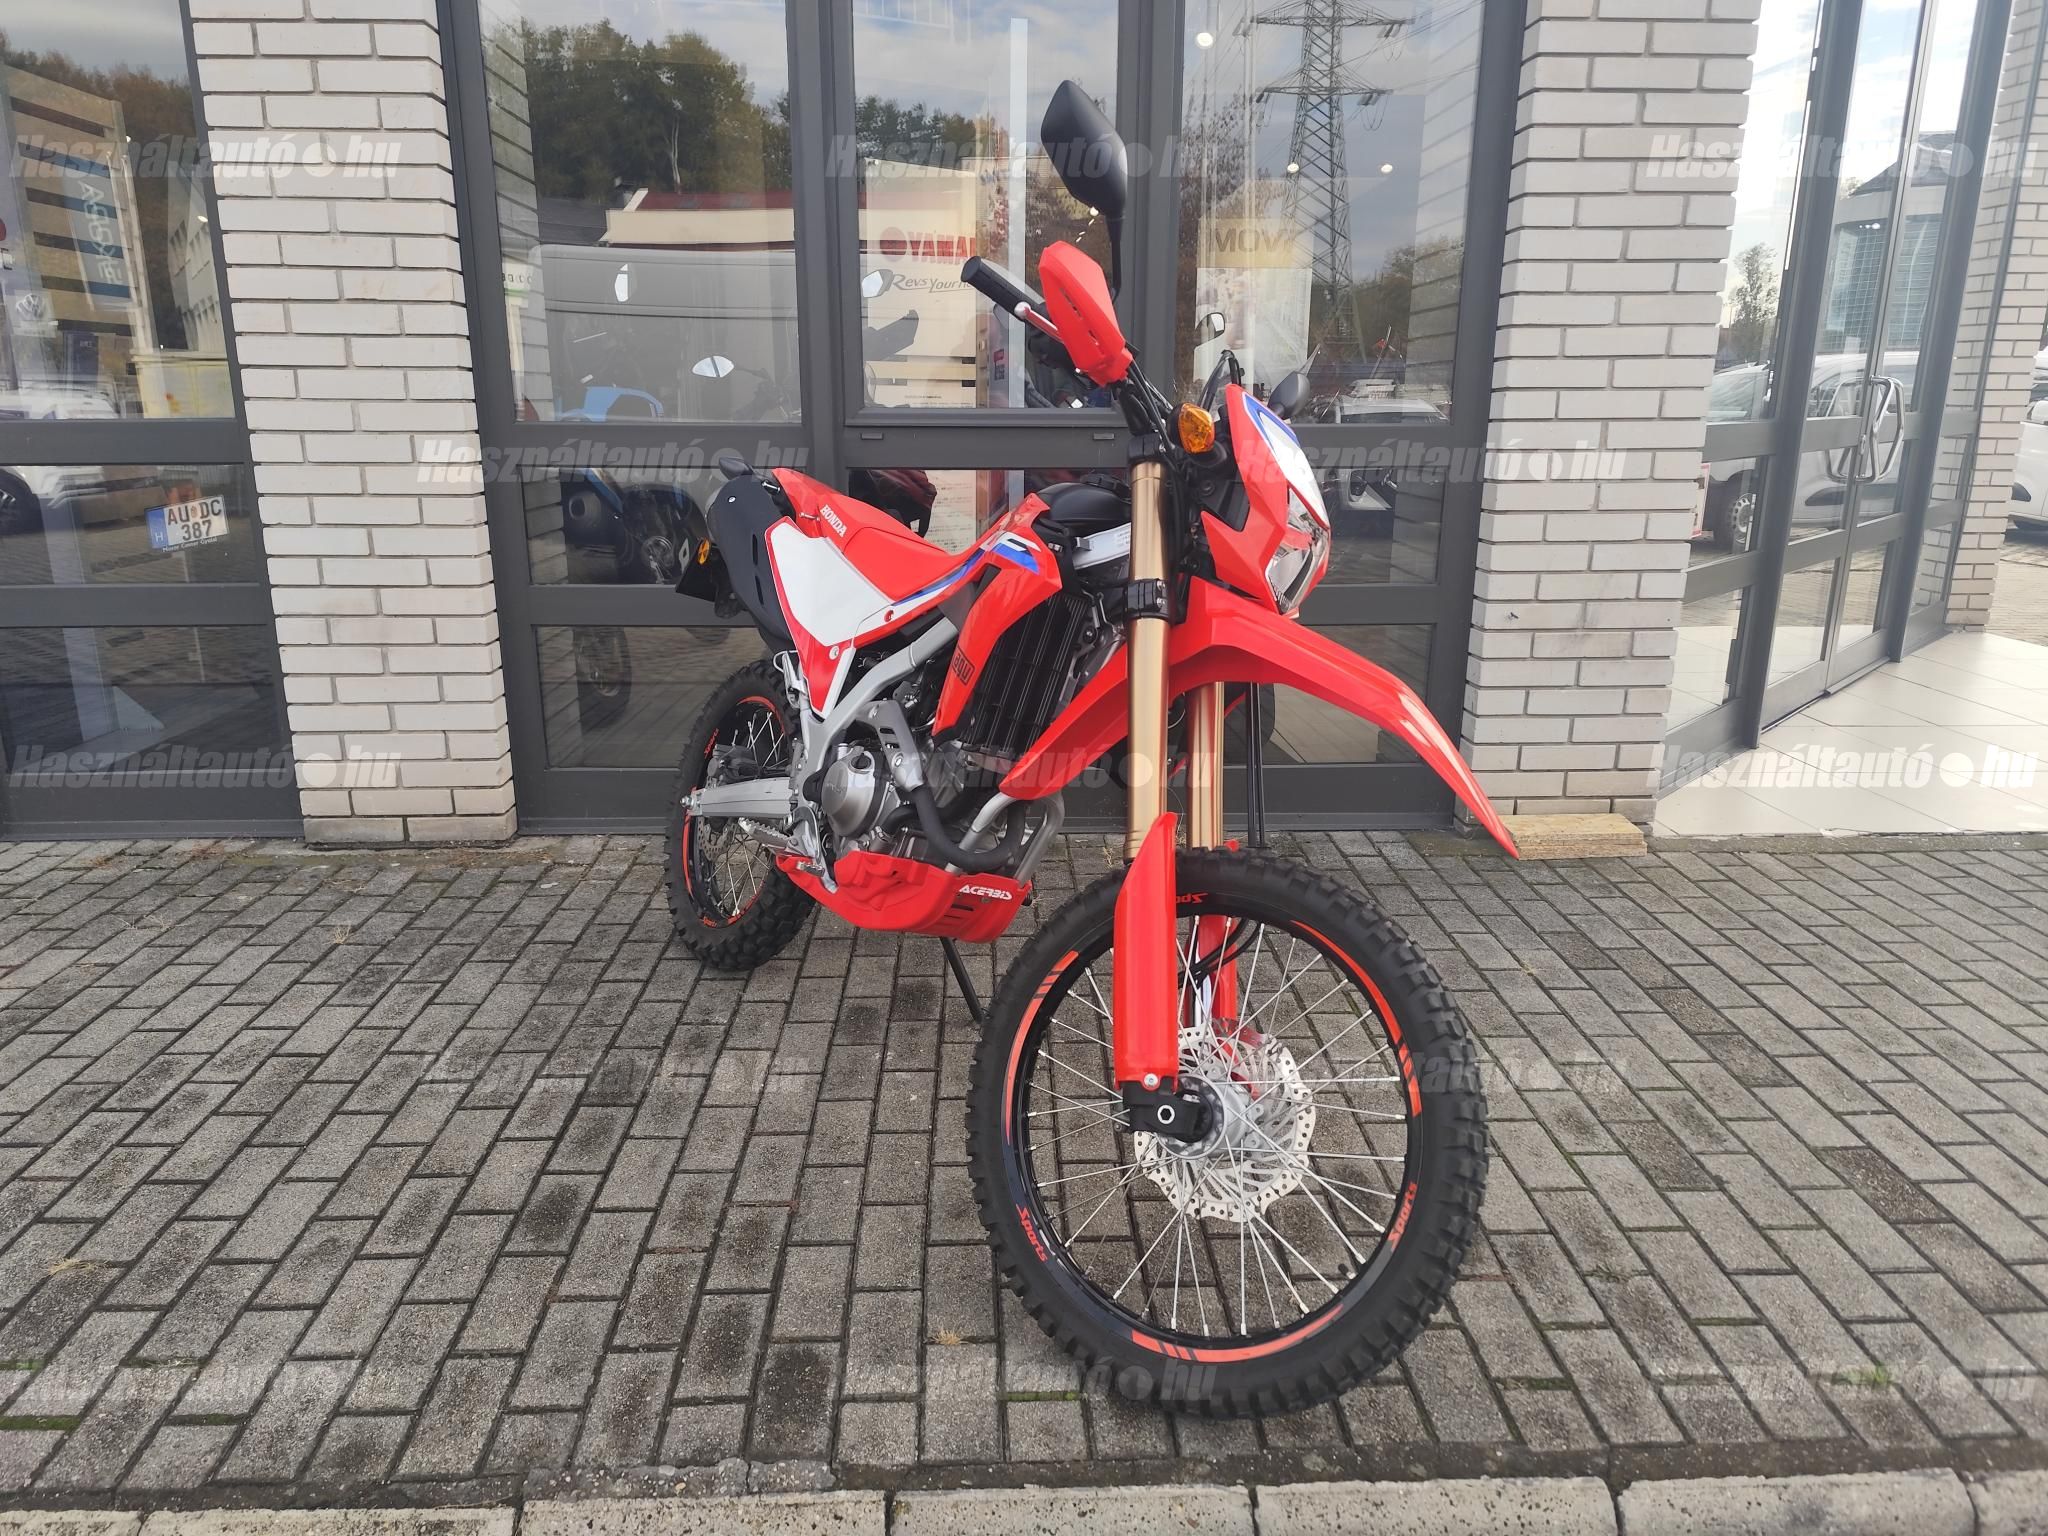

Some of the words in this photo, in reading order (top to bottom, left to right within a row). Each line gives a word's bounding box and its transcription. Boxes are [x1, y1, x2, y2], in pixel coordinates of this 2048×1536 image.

[168, 505, 190, 526] AU
[199, 499, 222, 519] DC
[820, 504, 848, 538] HONDA
[181, 519, 212, 541] 387
[959, 884, 1013, 901] ACERBIS
[1389, 1181, 1418, 1251] Sports
[1015, 1204, 1049, 1263] Sports
